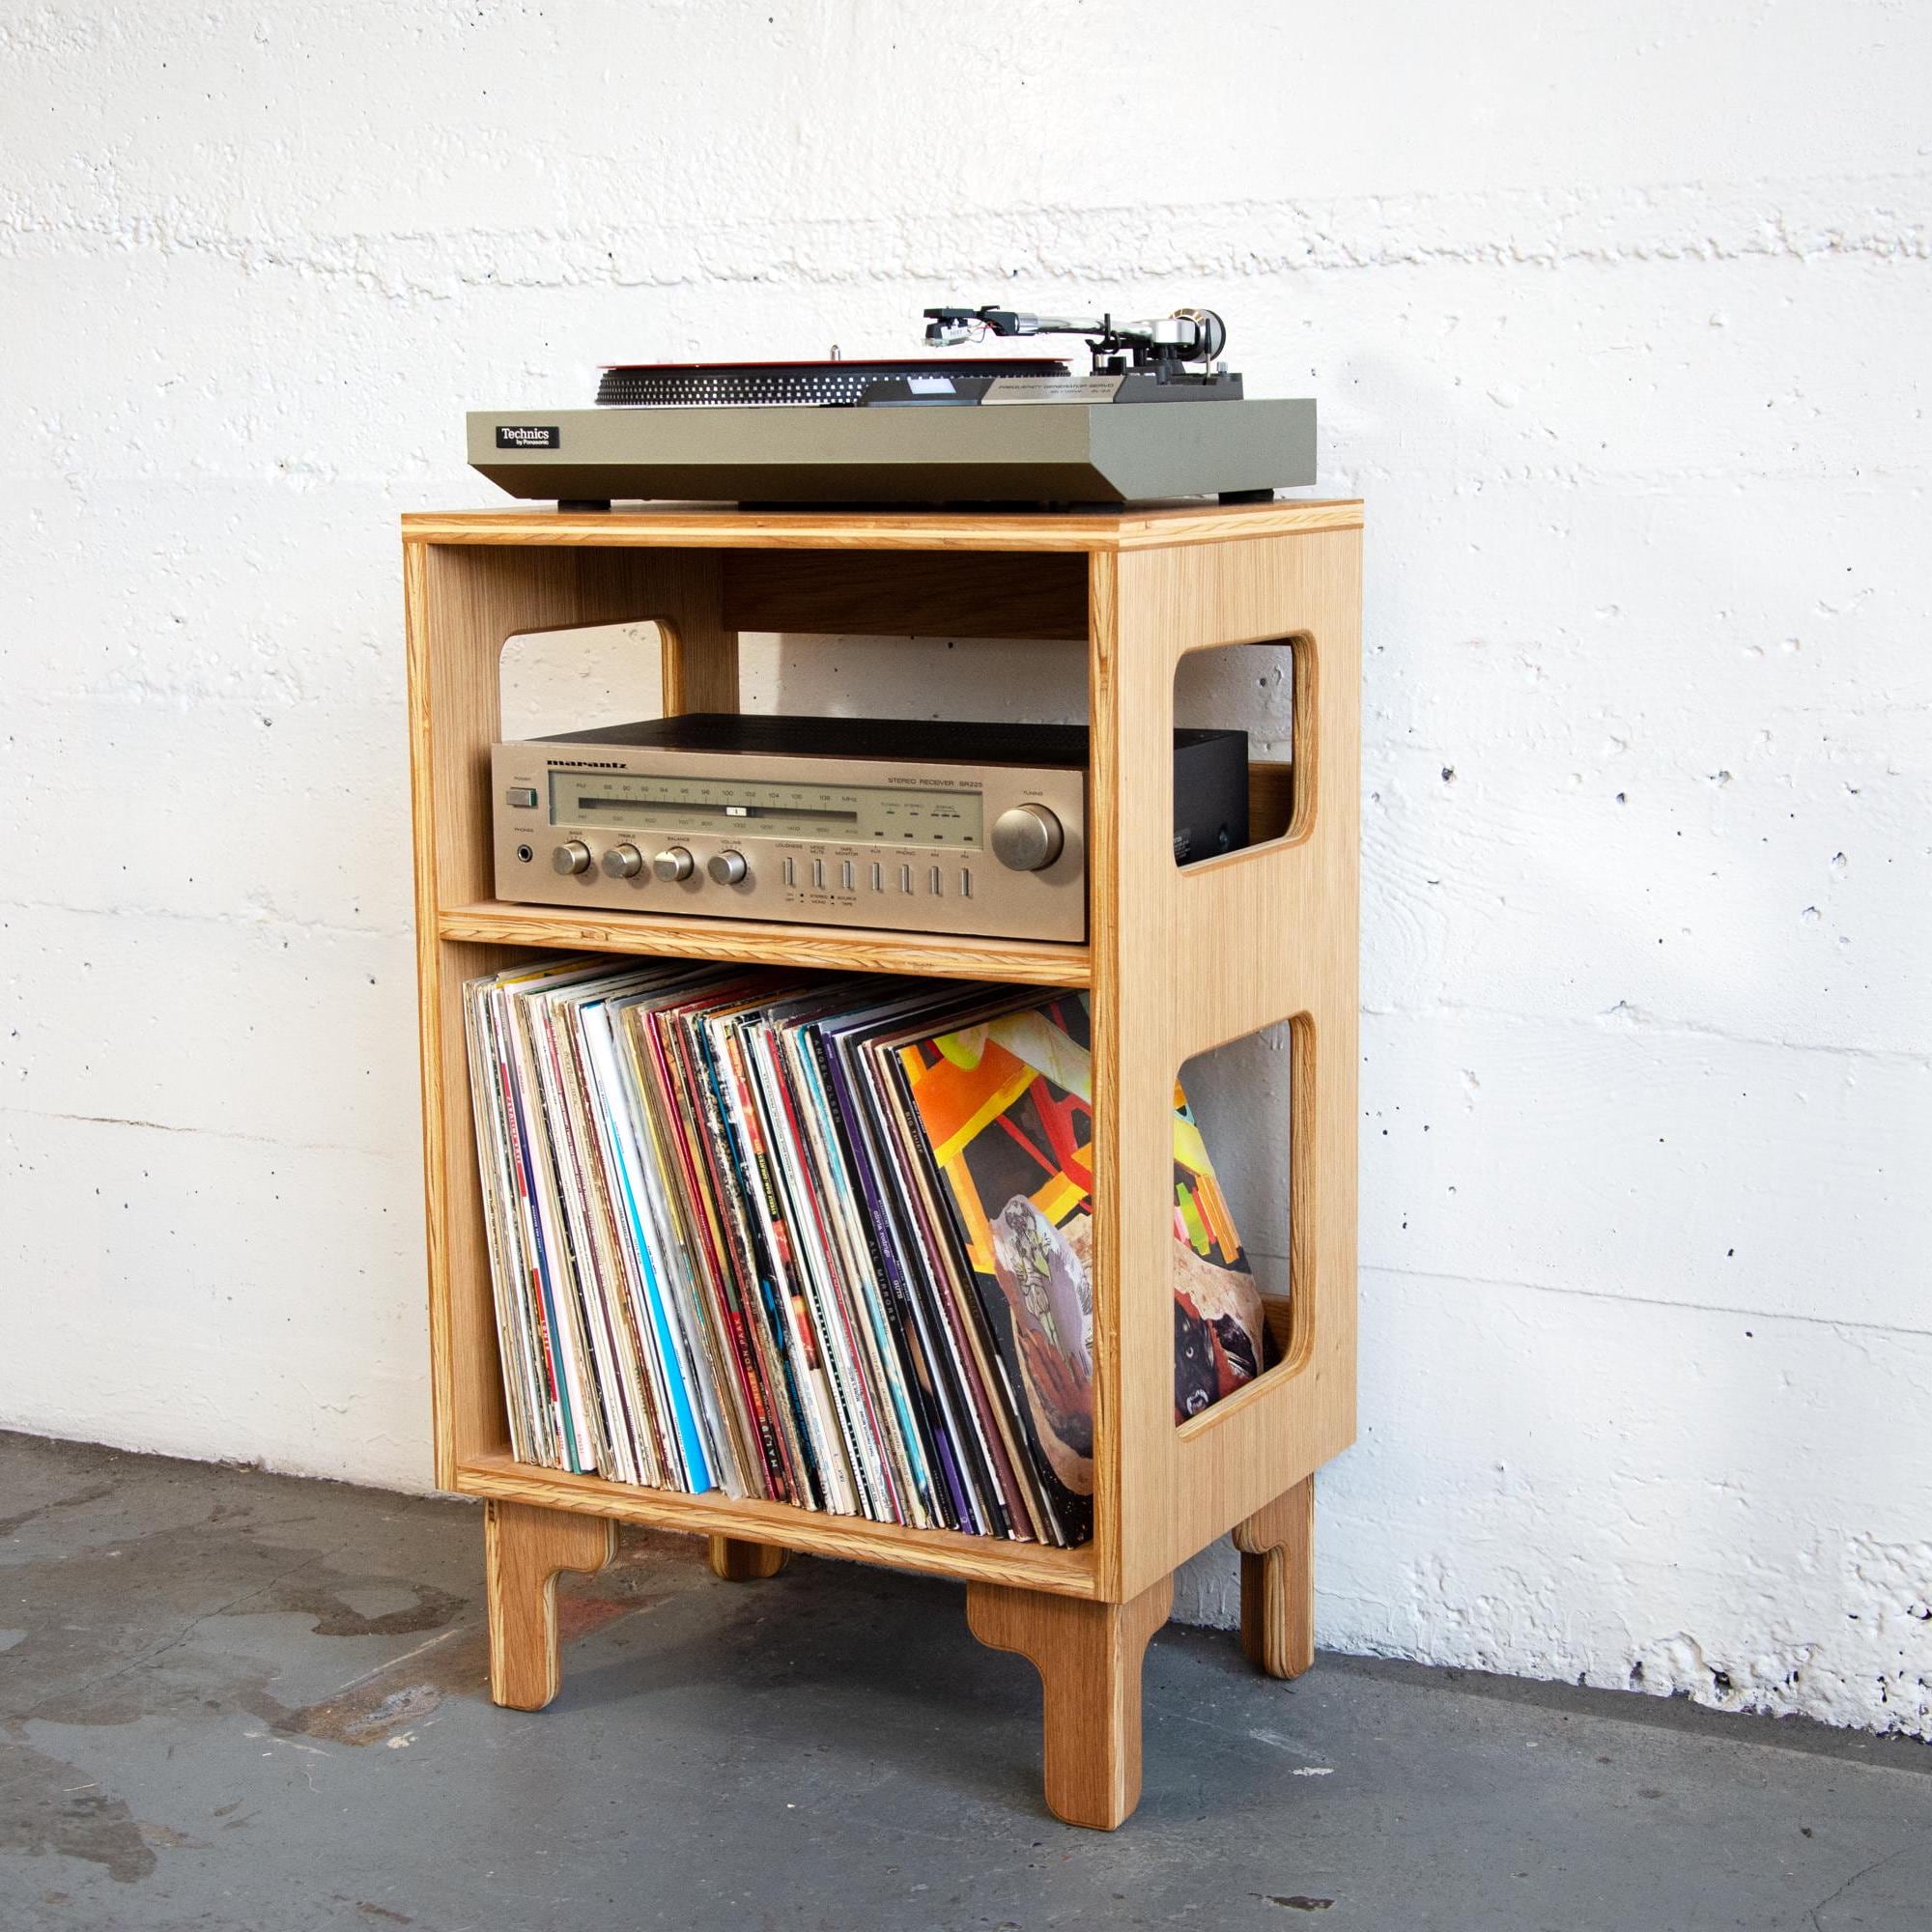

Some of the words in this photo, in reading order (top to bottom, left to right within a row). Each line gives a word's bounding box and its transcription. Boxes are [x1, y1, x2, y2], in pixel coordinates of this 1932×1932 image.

[501, 427, 550, 440] Technics
[547, 759, 628, 769] marantz
[812, 1038, 829, 1078] ANGEL
[825, 1084, 841, 1123] OLSEN
[504, 1094, 518, 1139] CAROLINE
[512, 1142, 521, 1165] ROSE
[903, 1110, 914, 1126] BIG
[910, 1128, 924, 1154] THIEF
[767, 1194, 777, 1215] STEELY
[872, 1209, 884, 1231] olivia
[877, 1231, 892, 1259] rodrigo
[867, 1239, 880, 1263] ALL
[875, 1267, 896, 1321] MIRRORS
[540, 1319, 550, 1350] LONER
[743, 1350, 766, 1408] ANDERSON
[759, 1415, 778, 1468] MALIBU
